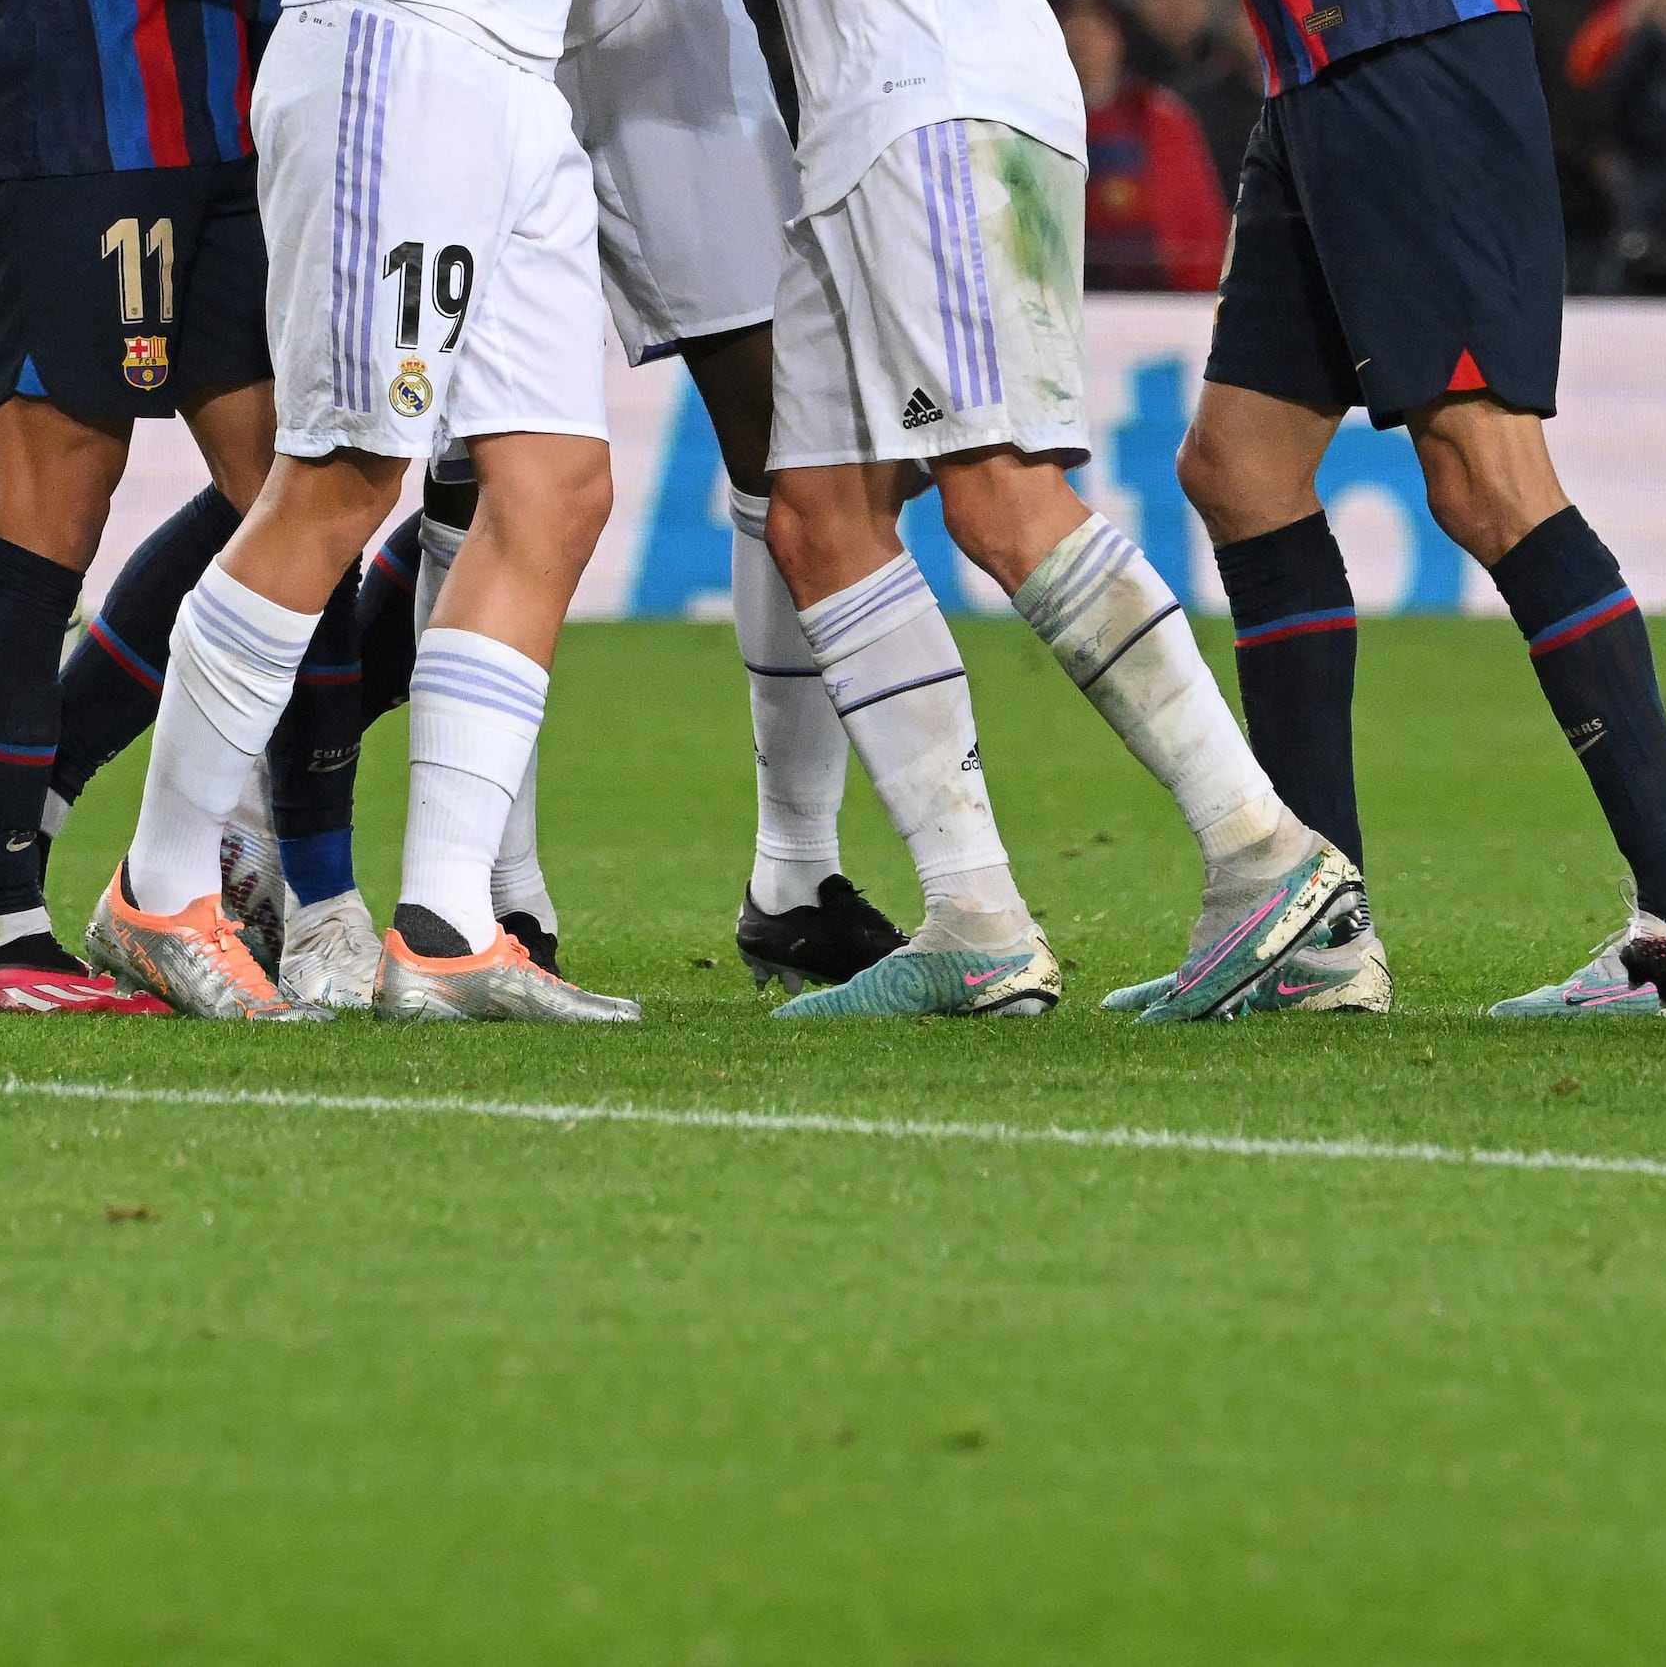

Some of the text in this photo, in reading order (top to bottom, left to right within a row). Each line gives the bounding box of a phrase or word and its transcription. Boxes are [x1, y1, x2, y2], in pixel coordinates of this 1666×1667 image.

[101, 217, 174, 324] 11
[383, 241, 474, 354] 19
[903, 409, 944, 430] adidas
